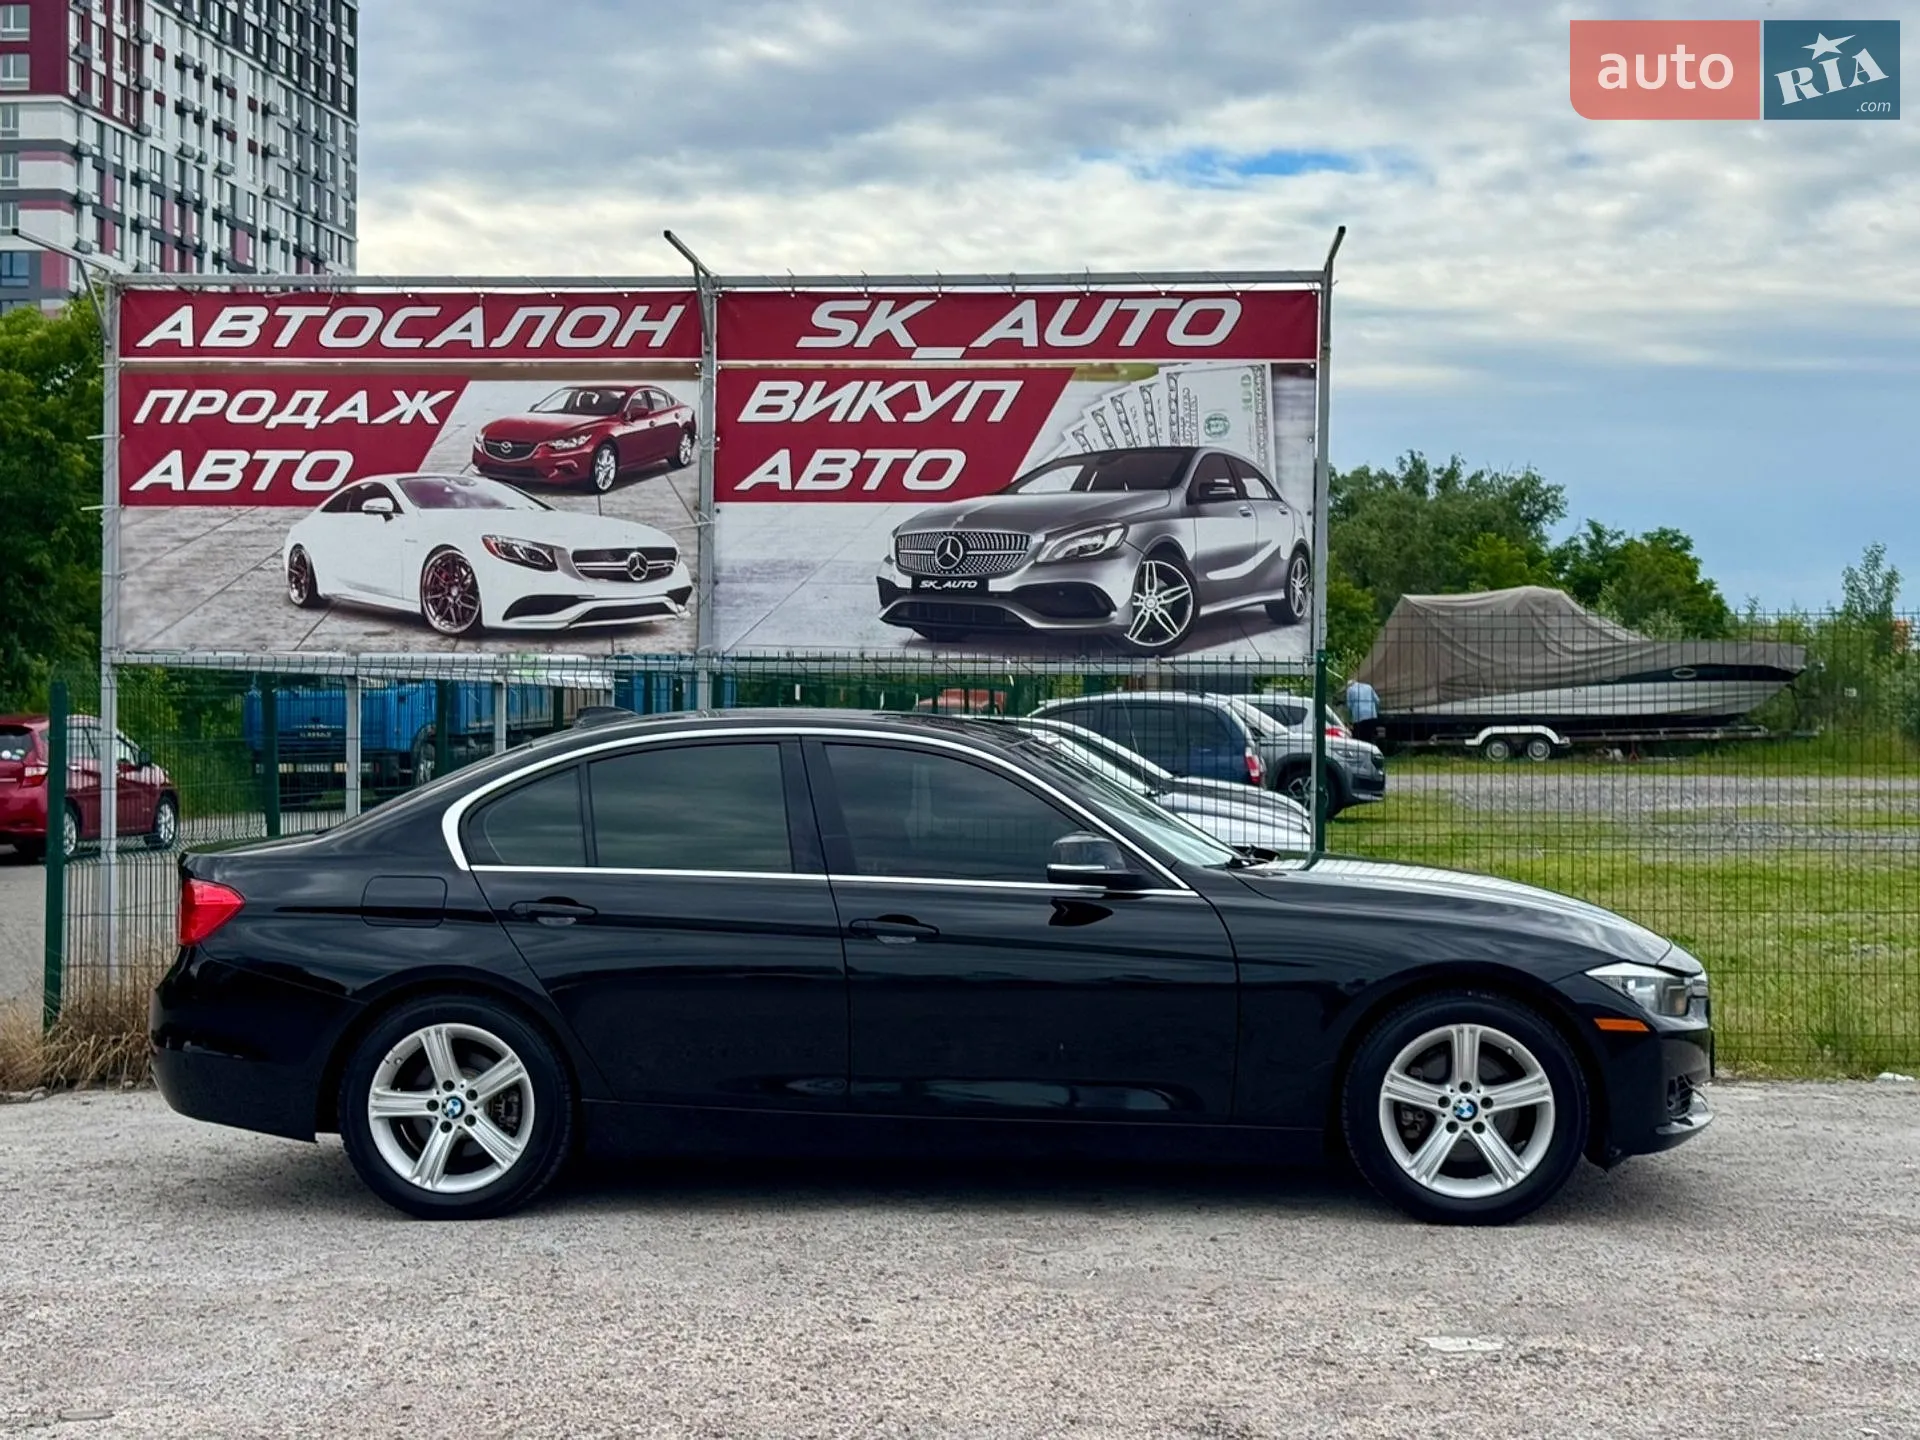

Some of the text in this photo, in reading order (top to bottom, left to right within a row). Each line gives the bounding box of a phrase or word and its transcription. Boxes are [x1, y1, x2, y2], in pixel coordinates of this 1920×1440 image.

[134, 304, 687, 349] АВТОСАЛОН
[795, 298, 1243, 359] SK_AUTO
[132, 389, 456, 430] ПРОДАЖ
[736, 379, 1025, 423] ВИКУП
[128, 449, 355, 492] АВТО
[732, 448, 968, 491] АВТО
[919, 579, 979, 590] SK_AUTO
